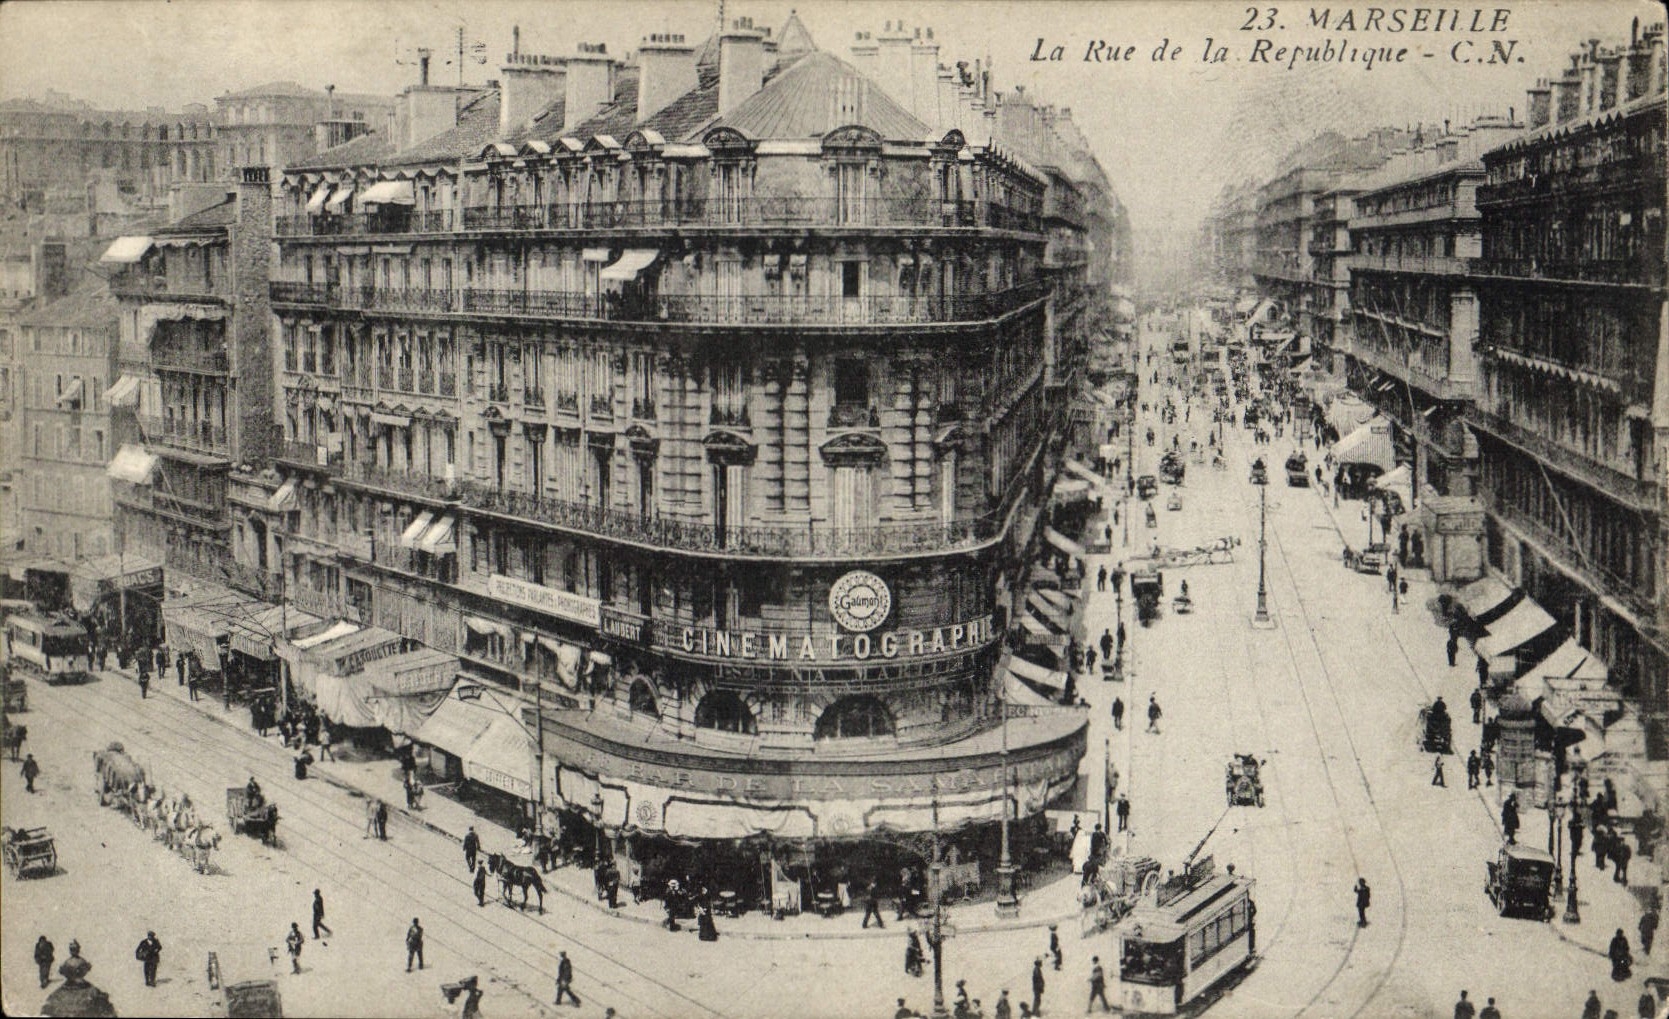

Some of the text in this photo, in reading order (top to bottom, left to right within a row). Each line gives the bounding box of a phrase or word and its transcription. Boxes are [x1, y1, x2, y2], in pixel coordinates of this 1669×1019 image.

[632, 764, 694, 787] BAR
[717, 775, 767, 792] DE
[792, 779, 844, 793] LA
